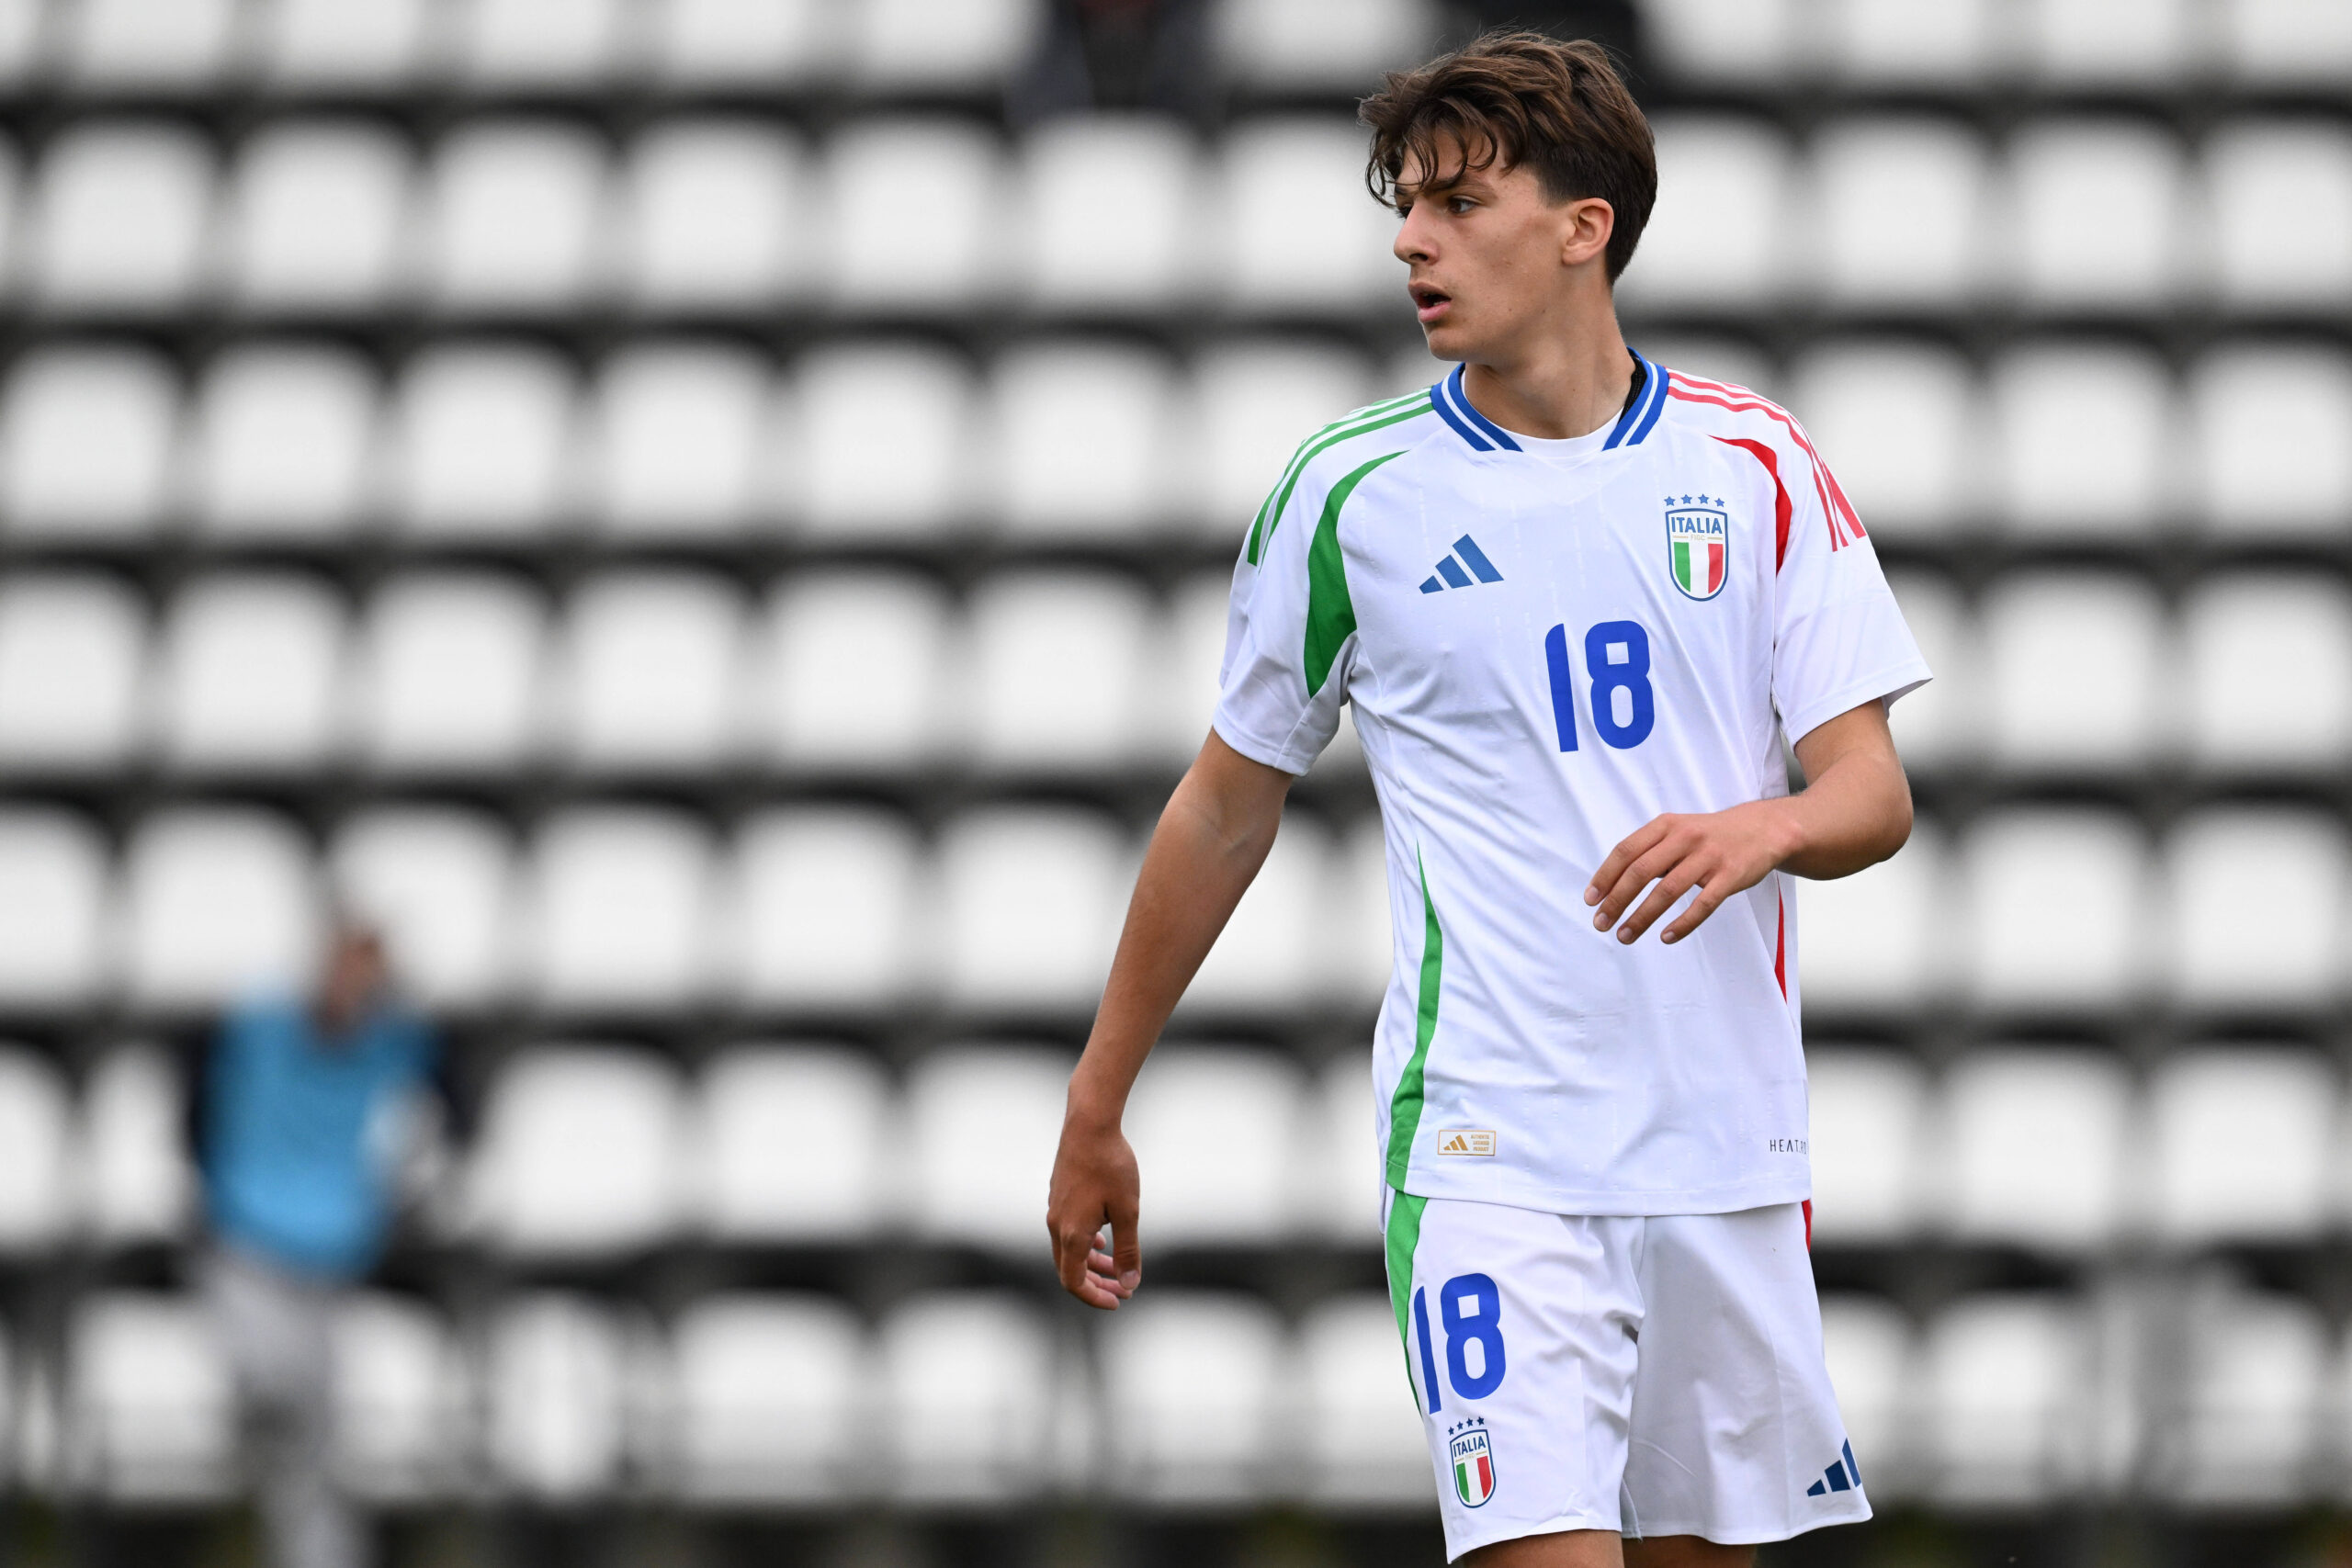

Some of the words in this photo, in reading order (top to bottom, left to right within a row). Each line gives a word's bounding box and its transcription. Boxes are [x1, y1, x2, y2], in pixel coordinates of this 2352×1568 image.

[1671, 517, 1723, 534] ITALIA
[1545, 620, 1655, 752] 18
[1414, 1272, 1507, 1415] 18
[1453, 1436, 1486, 1457] ITALIA
